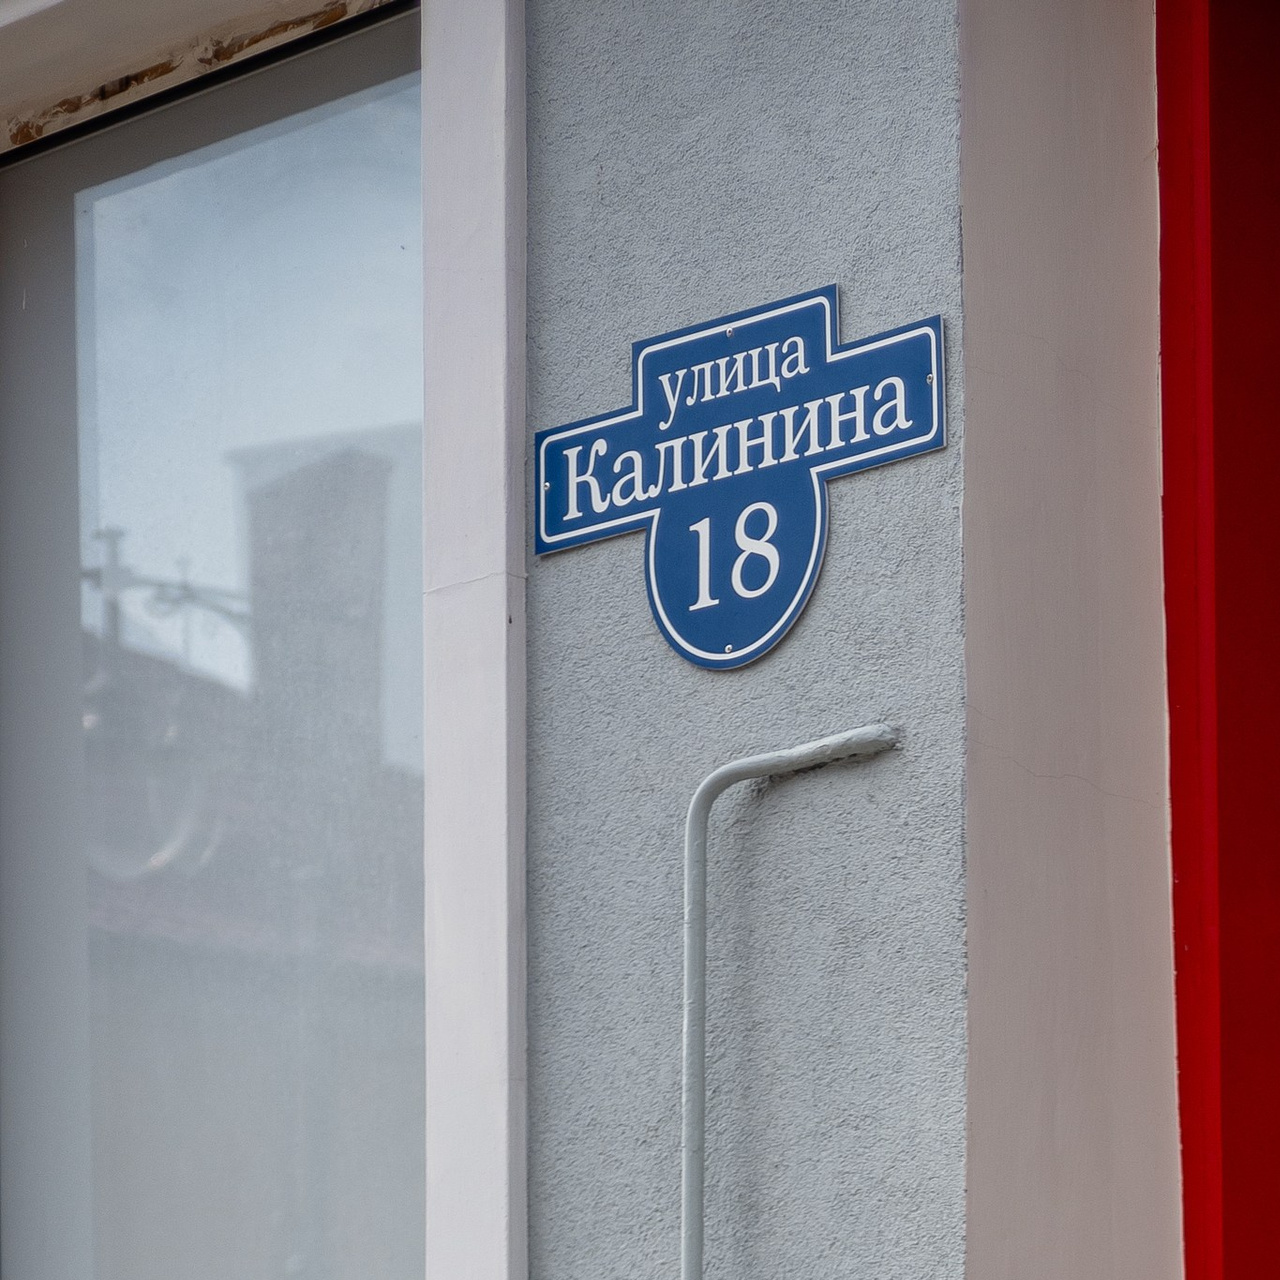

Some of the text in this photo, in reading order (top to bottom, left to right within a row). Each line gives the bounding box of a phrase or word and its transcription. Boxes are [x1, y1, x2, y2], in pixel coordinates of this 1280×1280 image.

[658, 335, 810, 430] улица
[562, 376, 914, 521] Калинина
[688, 501, 780, 611] 18
